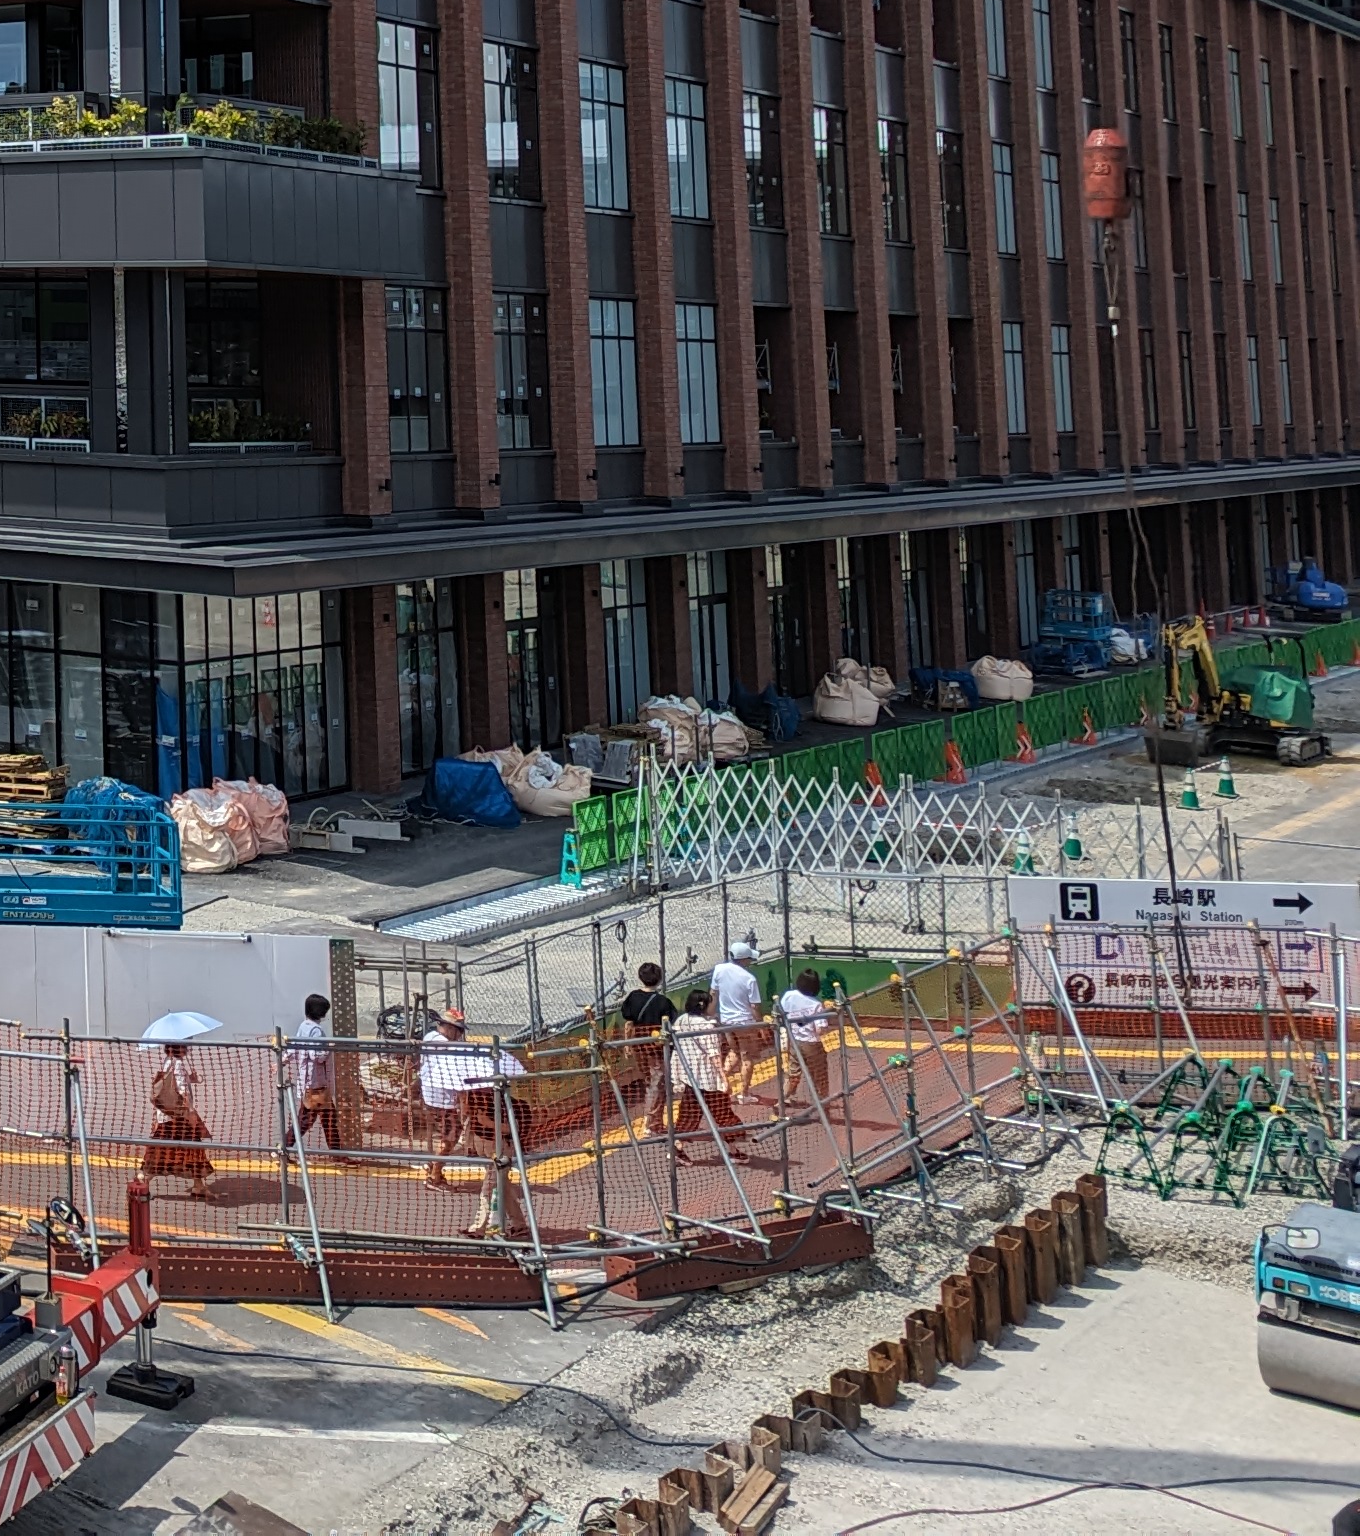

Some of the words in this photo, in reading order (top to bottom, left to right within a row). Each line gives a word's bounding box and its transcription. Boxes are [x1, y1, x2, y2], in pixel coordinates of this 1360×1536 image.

[1135, 909, 1191, 922] Nagaski
[1200, 911, 1243, 923] Station
[15, 1370, 40, 1397] KATO
